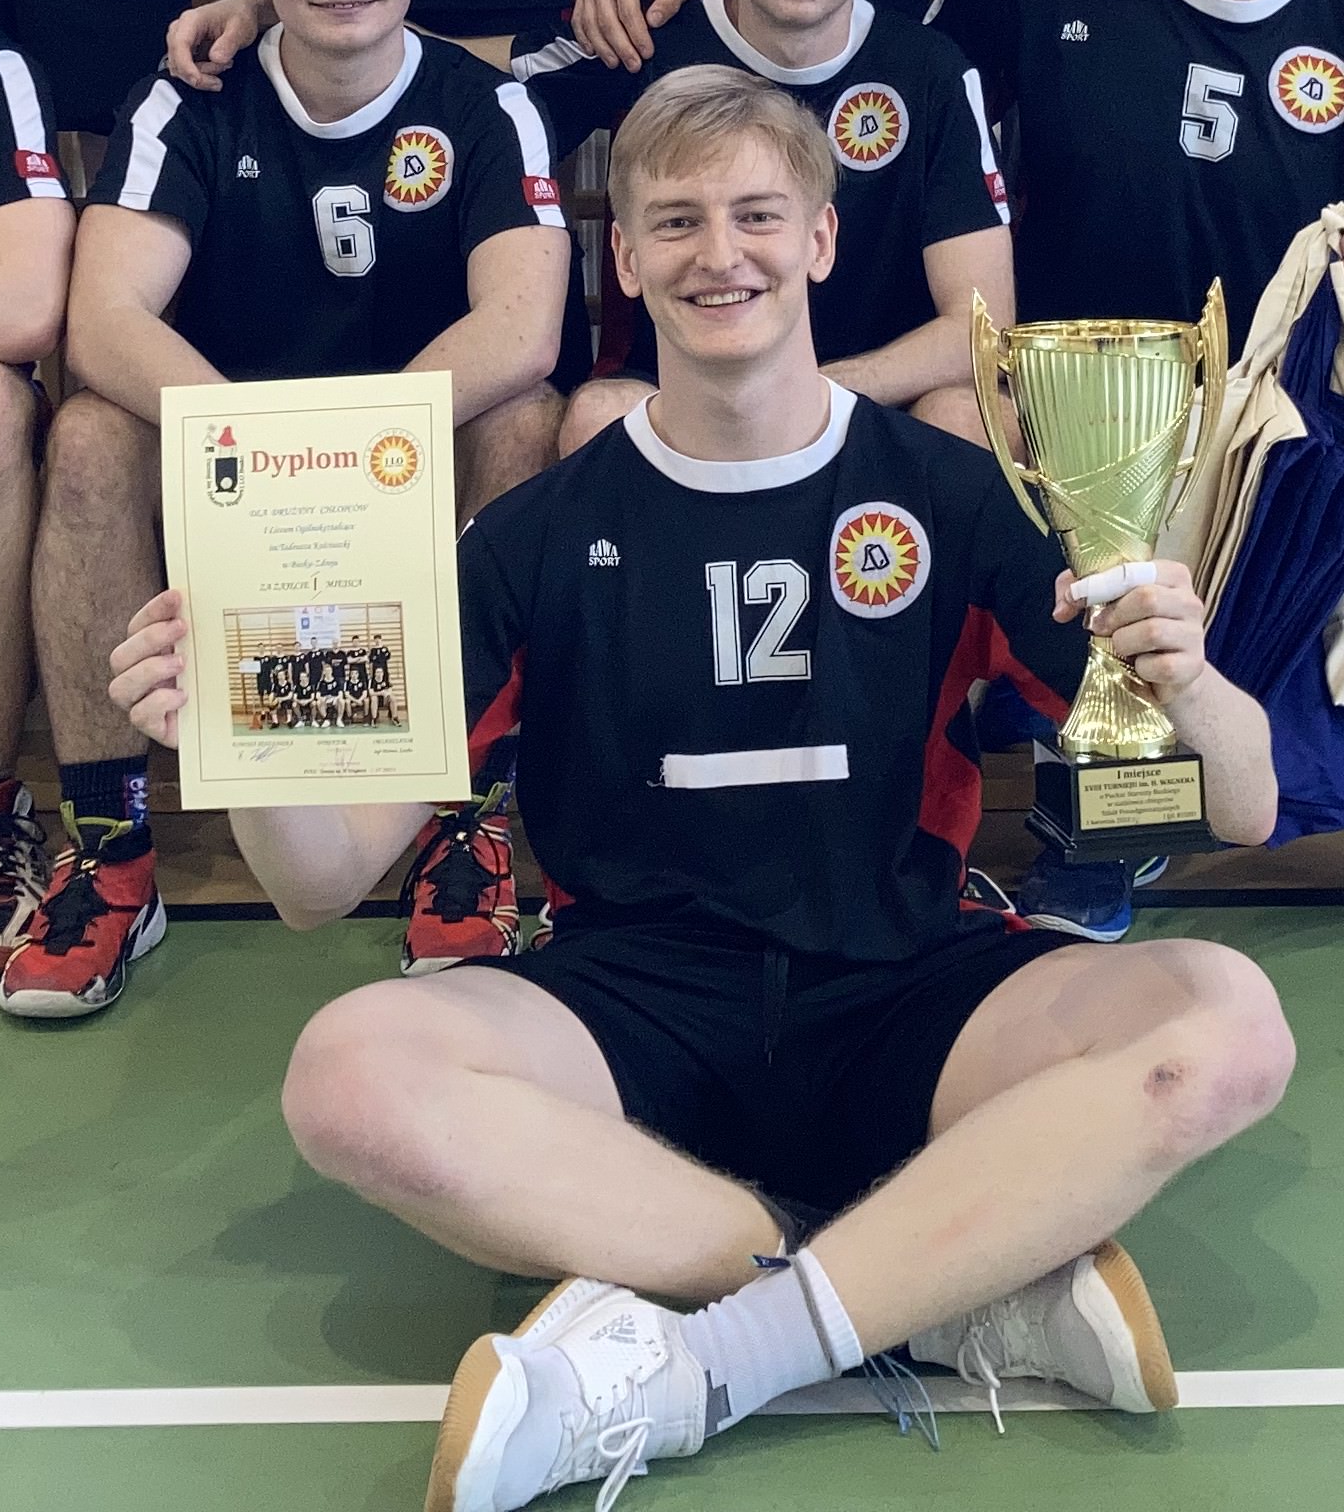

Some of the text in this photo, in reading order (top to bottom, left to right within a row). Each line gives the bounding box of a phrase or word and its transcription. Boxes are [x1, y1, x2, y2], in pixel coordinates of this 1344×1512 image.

[1179, 62, 1245, 163] 5
[311, 184, 377, 278] 6
[250, 446, 360, 479] Dyplom
[588, 556, 622, 567] SPORT
[705, 558, 812, 686] 12
[1117, 768, 1162, 780] I miejsce
